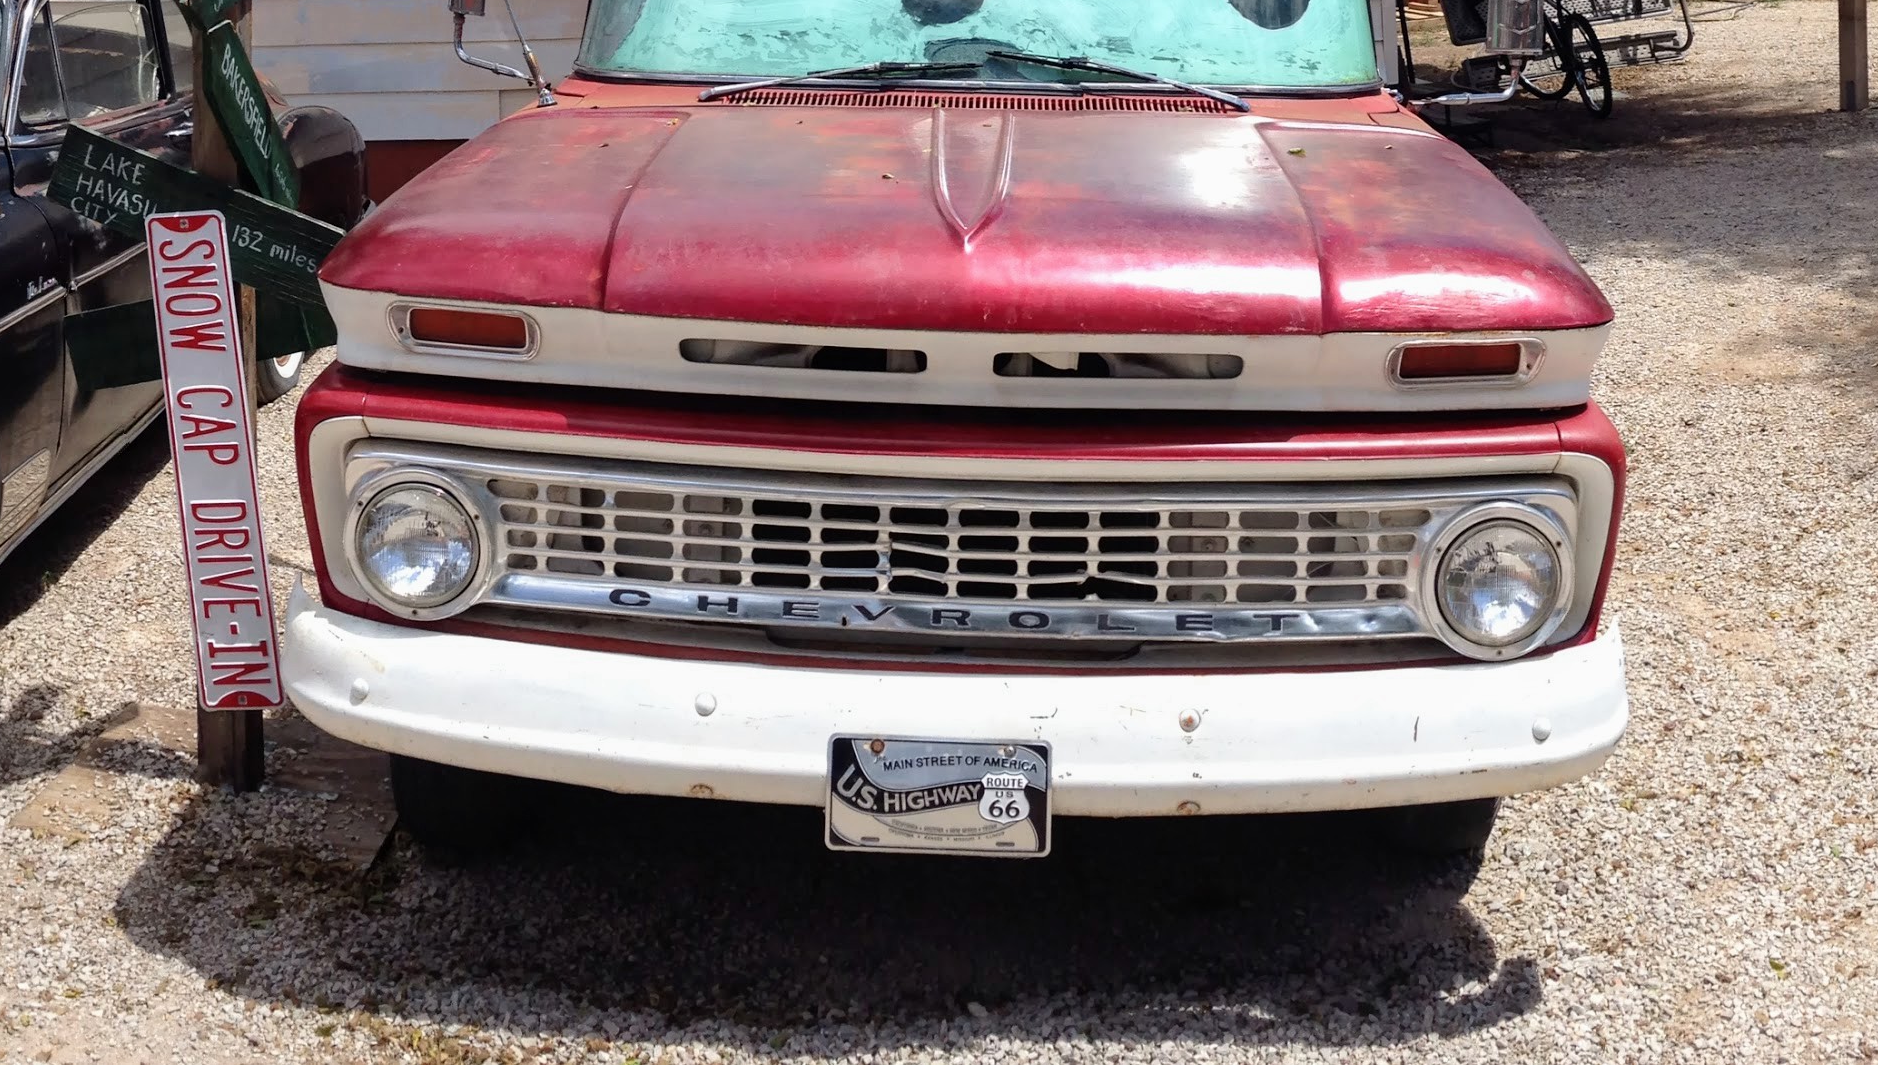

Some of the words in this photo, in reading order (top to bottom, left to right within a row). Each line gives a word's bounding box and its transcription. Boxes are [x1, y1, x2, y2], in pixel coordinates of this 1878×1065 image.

[221, 43, 273, 160] BAKERSFIELD
[82, 144, 147, 186] LAKE
[70, 196, 119, 226] CITY
[231, 224, 264, 253] 132
[269, 243, 318, 275] miles
[158, 238, 228, 353] SNOW
[175, 385, 240, 466] CAP
[189, 500, 272, 688] DRIVE-IN
[607, 588, 1301, 633] CHEVROLET
[883, 756, 914, 772] MAIN
[915, 754, 962, 768] STREET
[964, 755, 981, 767] OF
[983, 757, 1039, 774] AMERICA
[986, 776, 1024, 788] ROUTE
[836, 763, 878, 812] U.S.
[883, 783, 982, 813] HIGHWAY
[988, 799, 1021, 819] 66
[995, 790, 1014, 799] US
